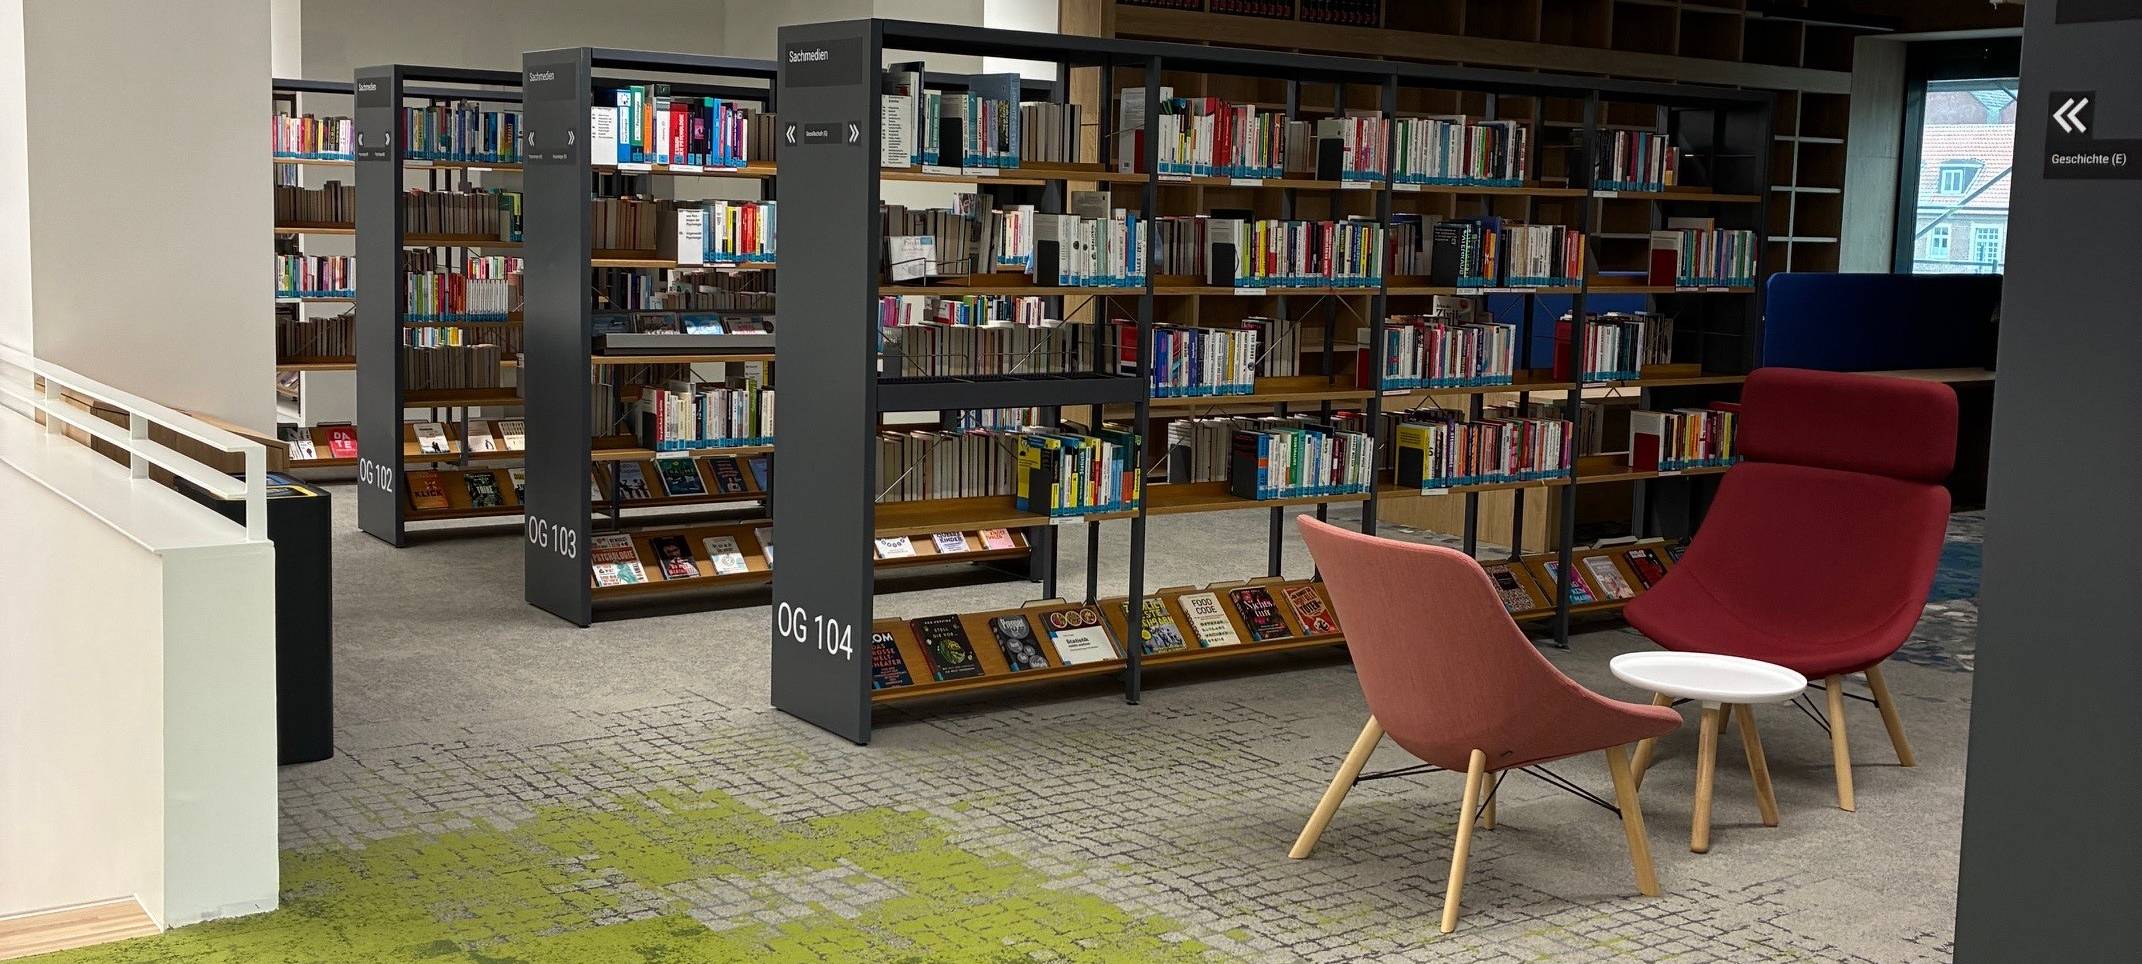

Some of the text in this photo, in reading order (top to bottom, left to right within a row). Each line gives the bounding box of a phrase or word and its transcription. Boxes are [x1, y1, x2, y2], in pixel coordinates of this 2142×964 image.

[789, 48, 829, 63] Sachmedien
[2051, 153, 2127, 167] Geschichte (E)
[333, 432, 351, 440] DA
[335, 440, 352, 449] TE
[360, 458, 392, 493] OG 102
[415, 488, 443, 498] KLICK
[528, 515, 577, 559] OG 103
[939, 536, 963, 544] KINDER
[592, 551, 635, 563] PSYCHOLOGIE
[1191, 599, 1213, 607] FOOD
[1244, 598, 1273, 609] Nichts
[1195, 606, 1217, 614] CODE
[778, 601, 853, 661] OG 104
[872, 633, 893, 643] OM
[1066, 637, 1089, 645] Statistik
